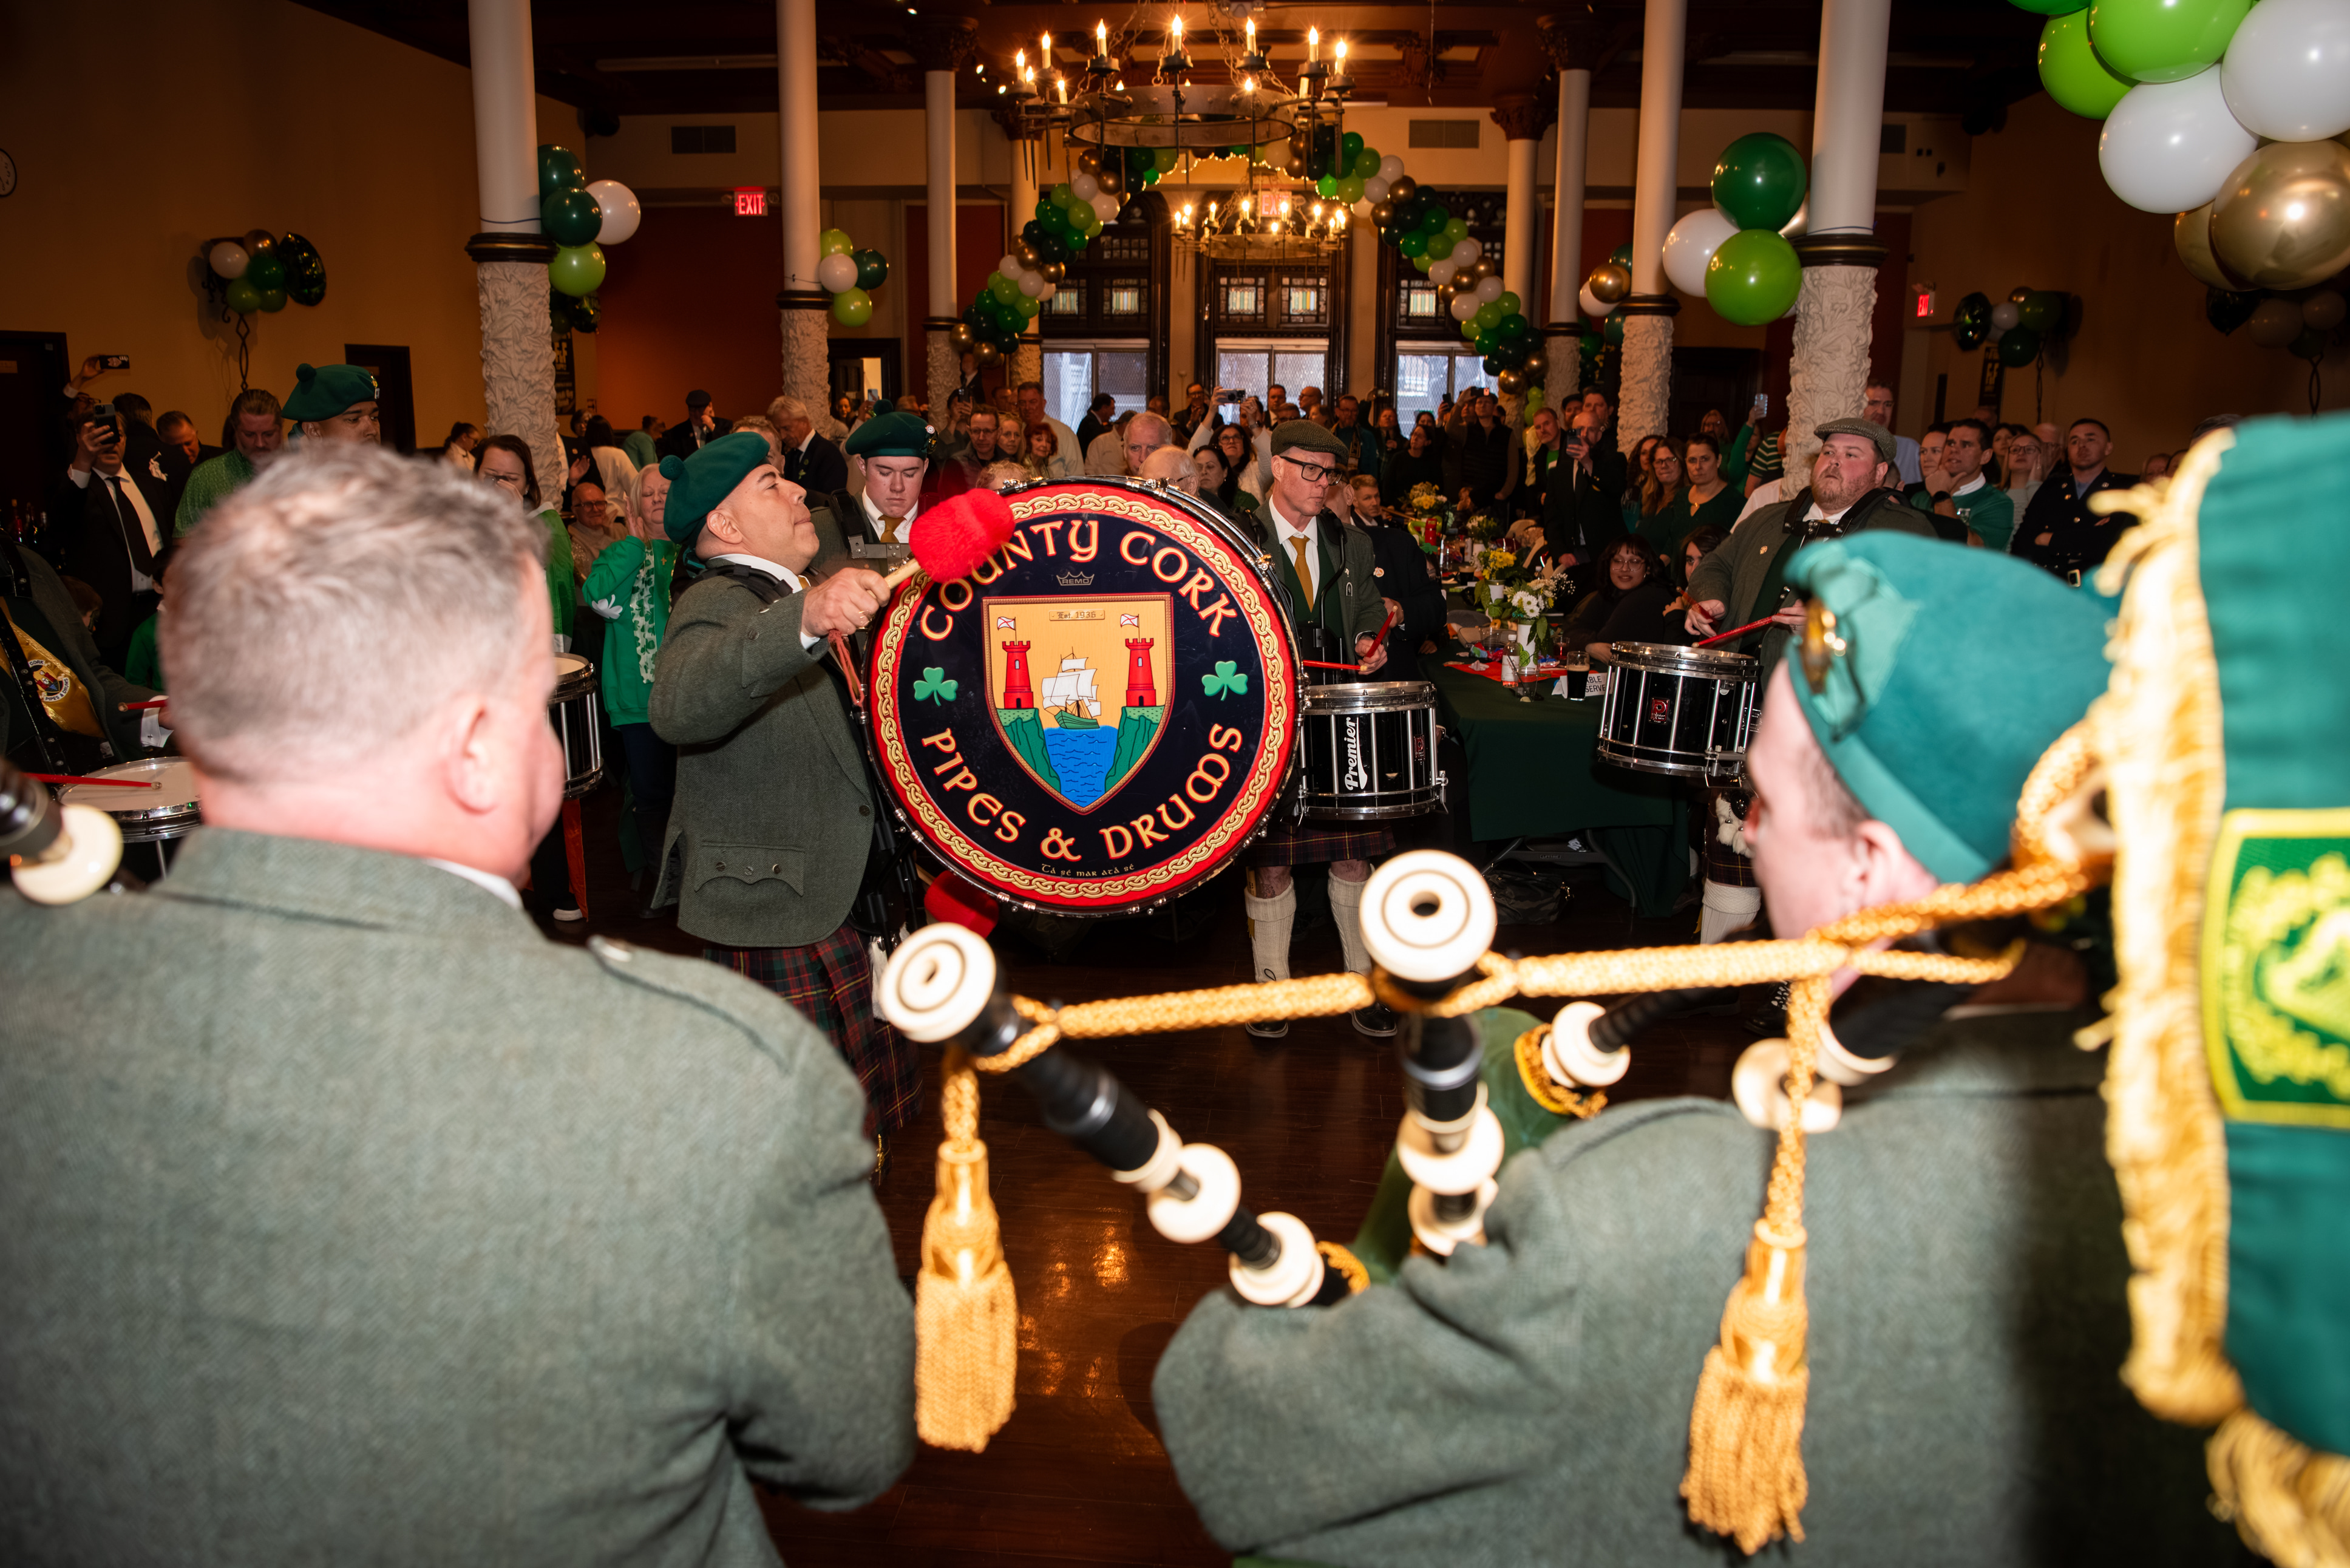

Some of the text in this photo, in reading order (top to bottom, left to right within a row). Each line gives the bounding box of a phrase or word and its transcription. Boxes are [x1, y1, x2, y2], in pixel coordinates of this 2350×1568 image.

[738, 194, 764, 215] EXIT
[1917, 294, 1930, 317] EXIT
[920, 520, 1238, 641] COUNTY CORK
[1585, 684, 1610, 693] SERVE
[1586, 676, 1602, 684] ABLE
[1344, 717, 1359, 790] Premier
[922, 724, 1243, 861] PIPES & DRUMS
